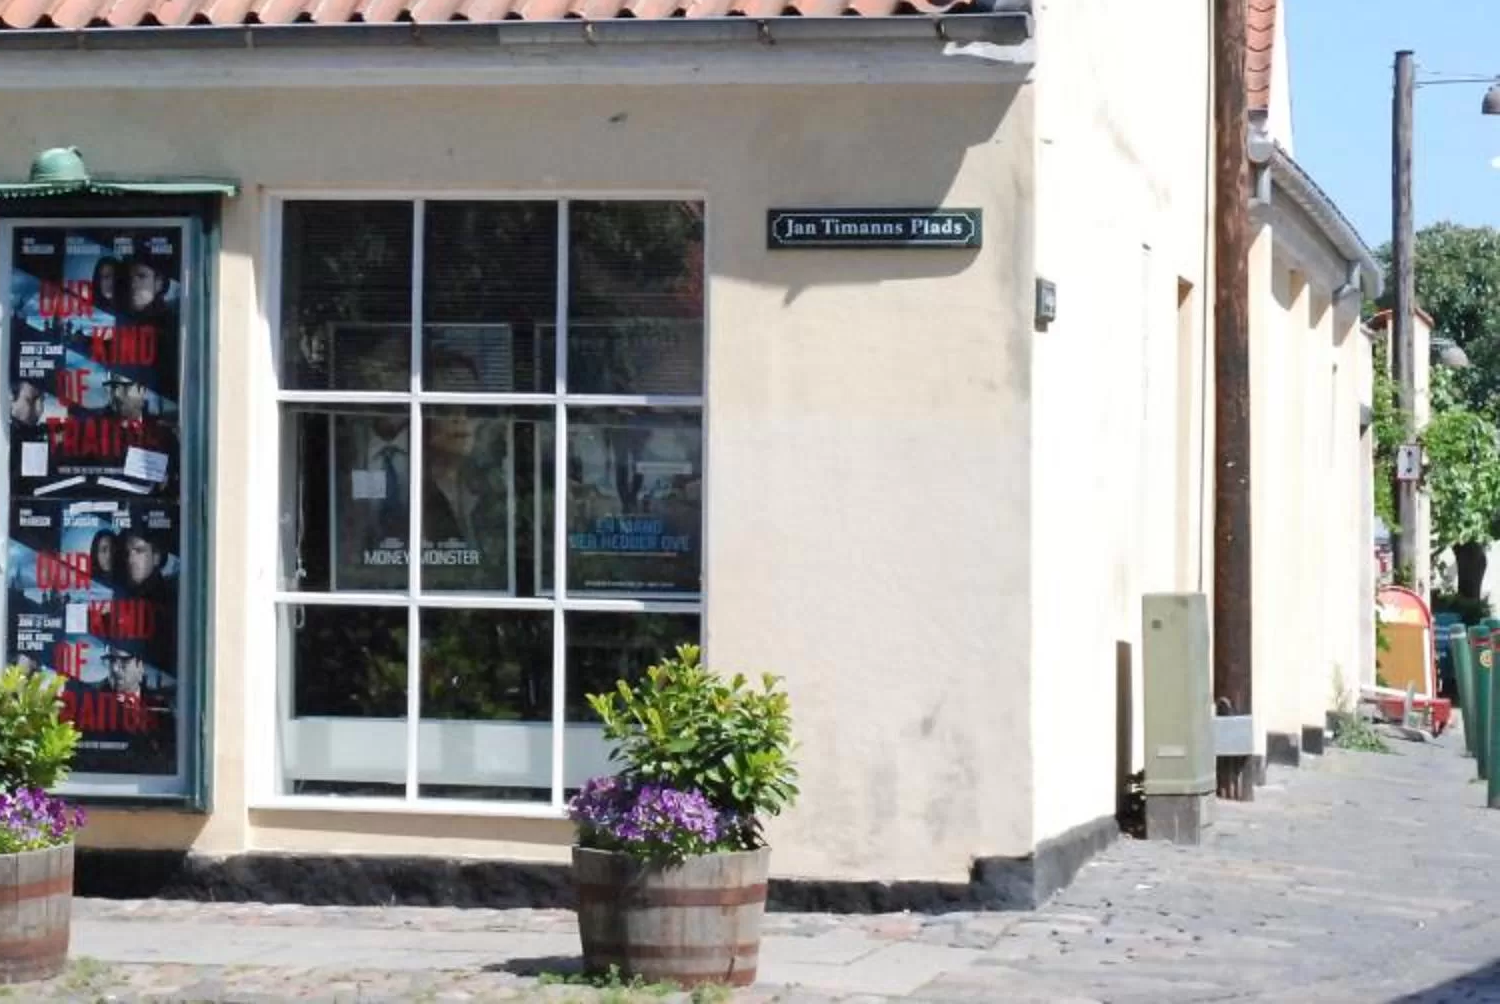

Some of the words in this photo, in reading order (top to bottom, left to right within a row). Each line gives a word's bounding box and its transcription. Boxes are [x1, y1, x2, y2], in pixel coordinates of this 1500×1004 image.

[785, 218, 817, 237] Jan
[821, 218, 903, 236] Timanns
[911, 218, 963, 236] Plads
[56, 368, 92, 407] OF
[36, 551, 92, 591] OUR
[364, 549, 412, 565] MONEY
[54, 640, 89, 681] OF
